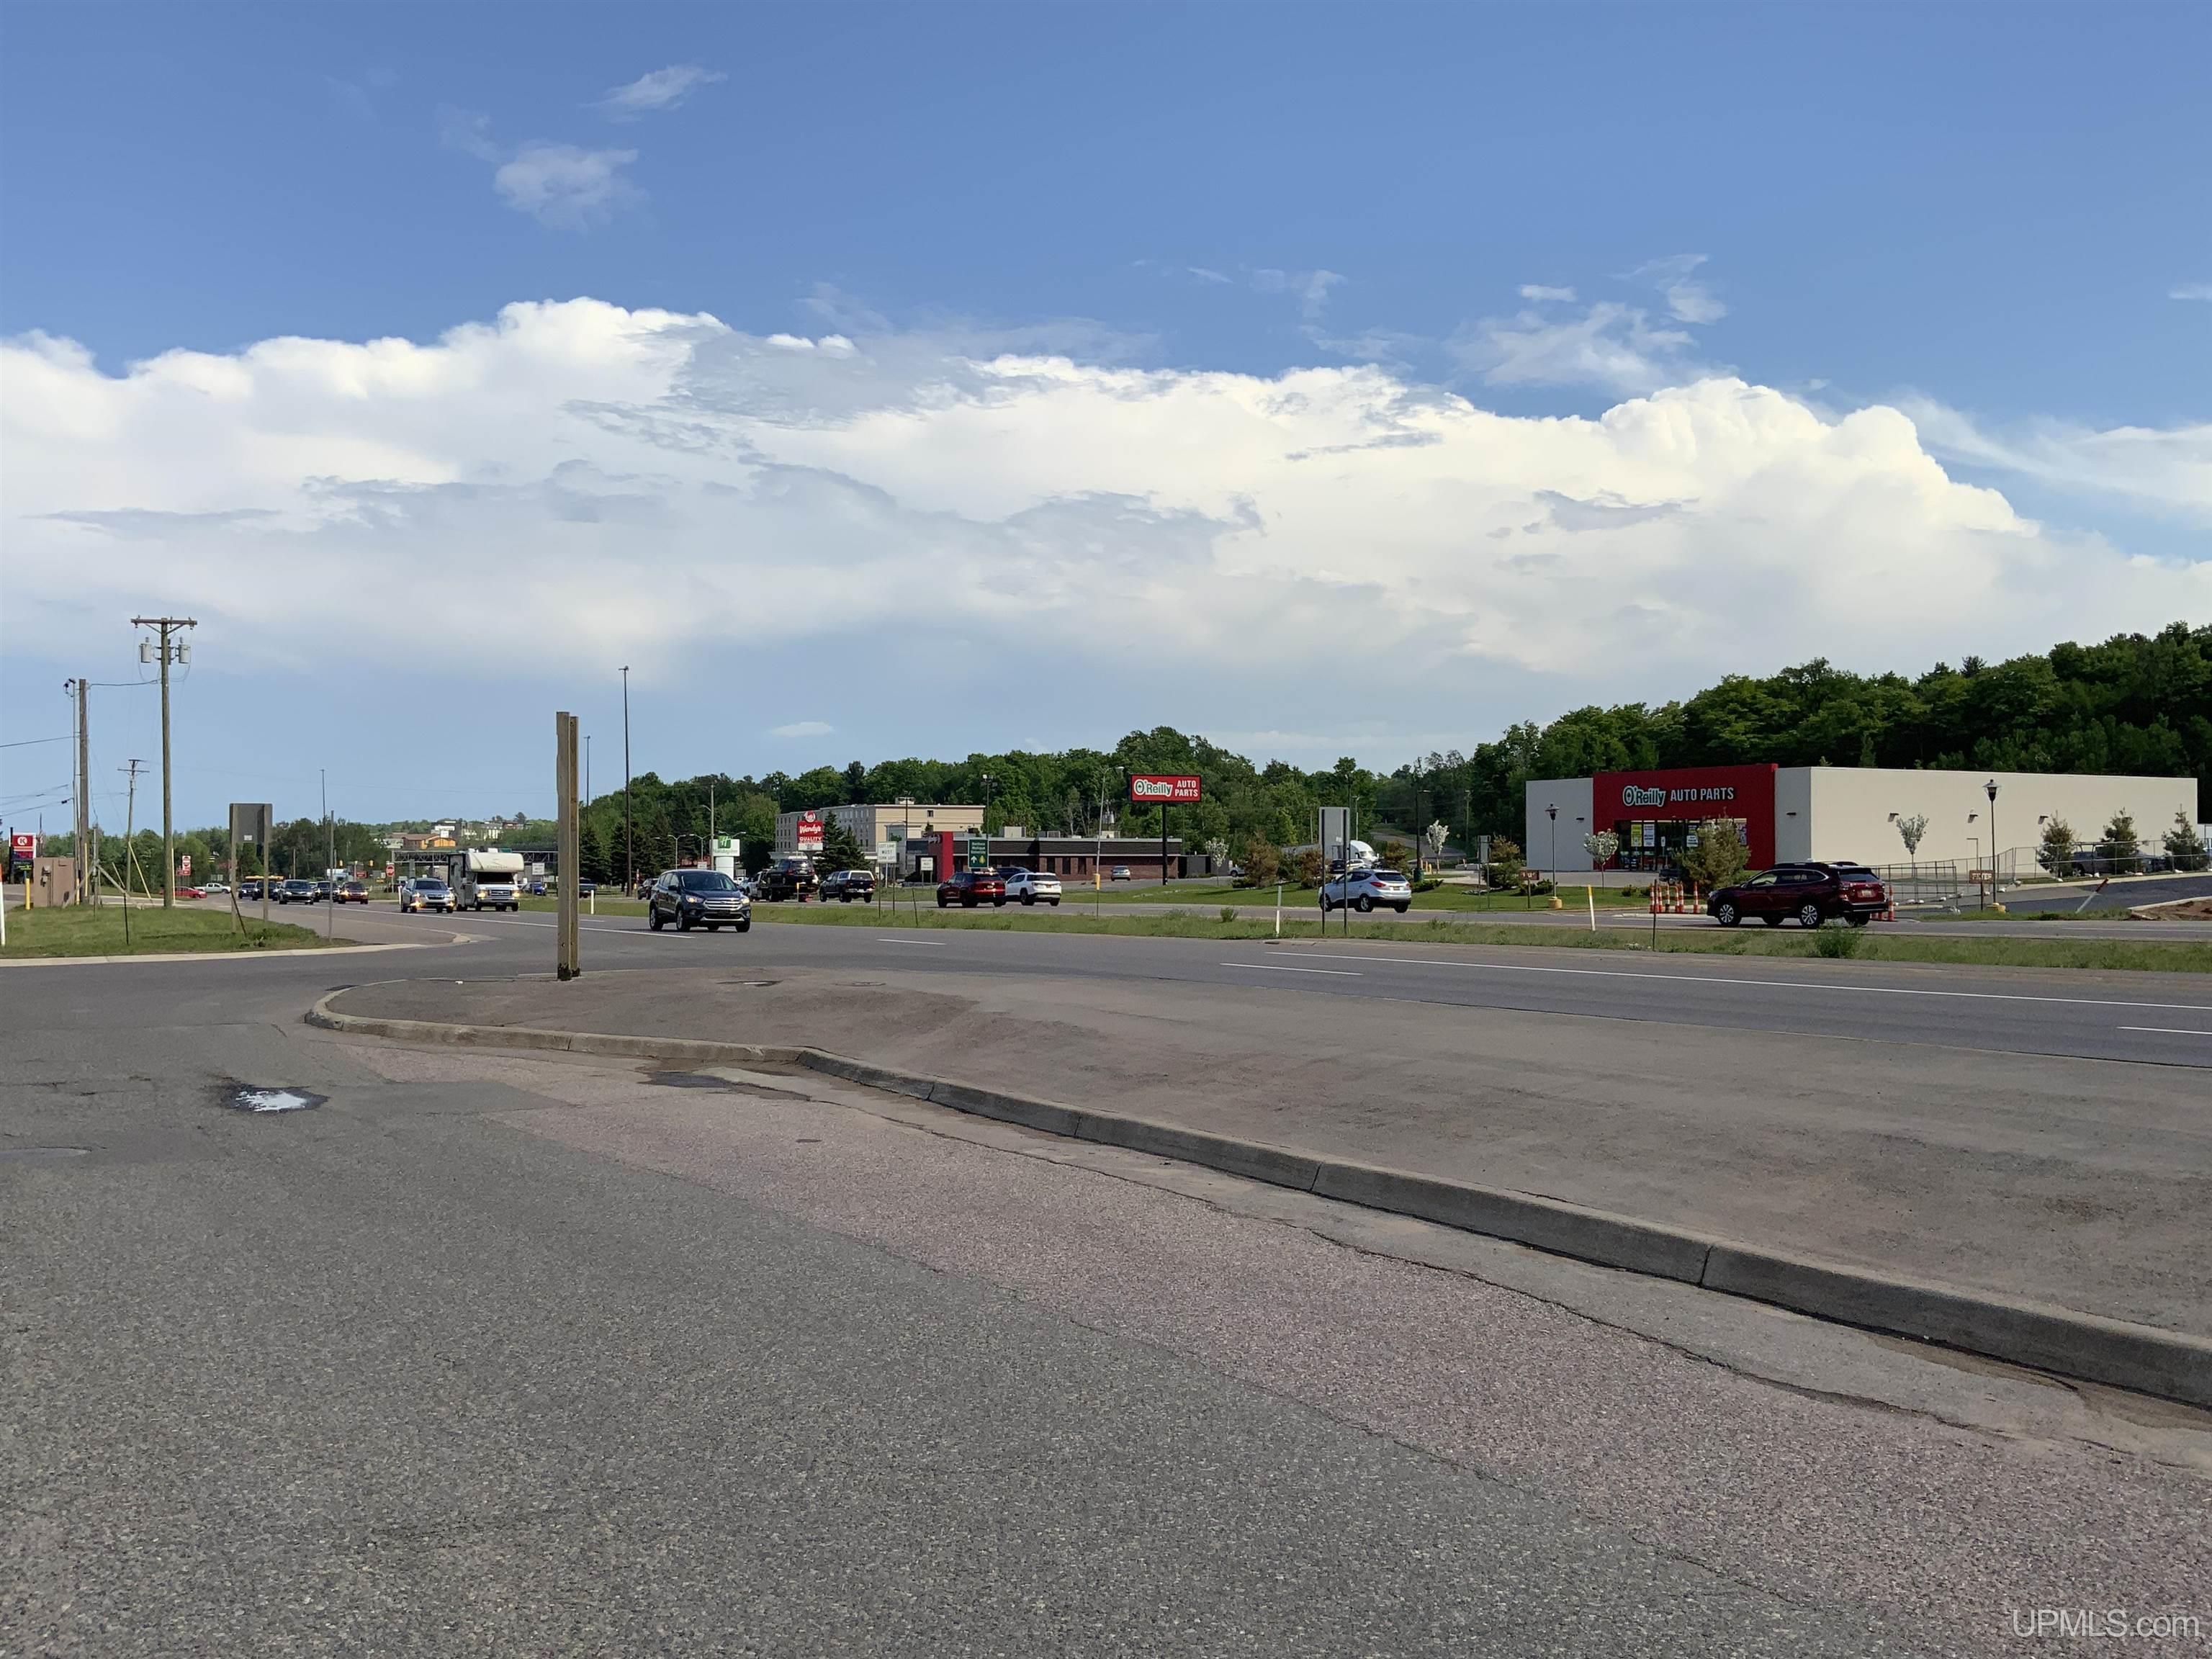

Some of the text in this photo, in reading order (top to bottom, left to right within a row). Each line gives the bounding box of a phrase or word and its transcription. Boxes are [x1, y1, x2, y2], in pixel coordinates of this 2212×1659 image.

[1134, 779, 1173, 796] O'Reilly
[1177, 780, 1197, 788] AUTO
[1174, 788, 1198, 797] PARTS
[1623, 786, 1735, 807] O'Reilly AUTO PARTS
[799, 824, 822, 834] Wendy's
